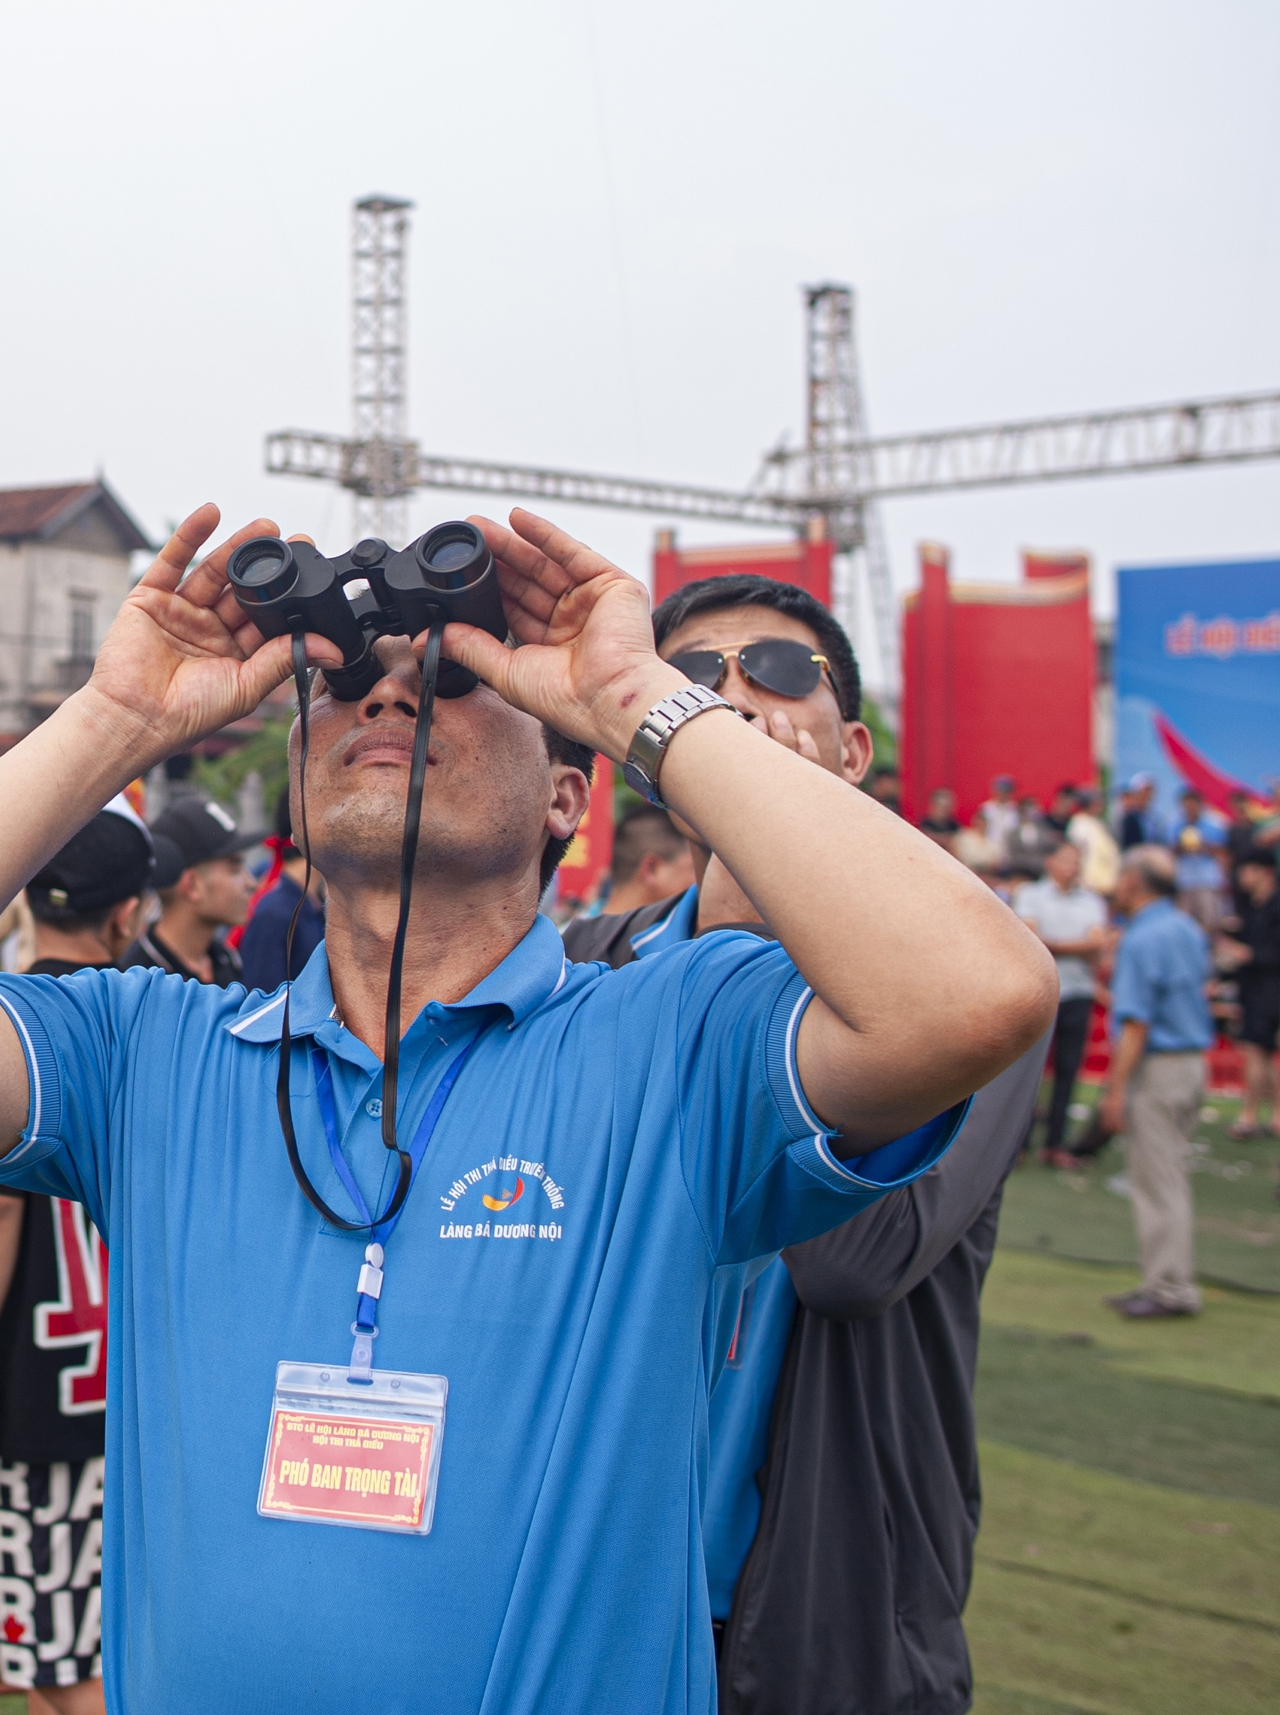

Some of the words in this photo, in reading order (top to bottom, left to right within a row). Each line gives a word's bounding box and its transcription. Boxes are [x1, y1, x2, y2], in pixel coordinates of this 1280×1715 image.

[448, 1179, 468, 1199] HỘI
[463, 1167, 482, 1185] THI
[439, 1221, 472, 1239] LÀNG
[474, 1220, 491, 1237] BÁ
[493, 1223, 536, 1239] DƯƠNG
[539, 1221, 562, 1242] NỘI
[286, 1422, 303, 1431] BTC
[316, 1425, 332, 1435] HỘI
[313, 1435, 328, 1446] HỘI
[330, 1437, 343, 1446] THI
[279, 1458, 310, 1487] PHÓ
[311, 1463, 343, 1490] BAN
[344, 1466, 392, 1498] TRỌNG
[393, 1468, 418, 1498] TÀI
